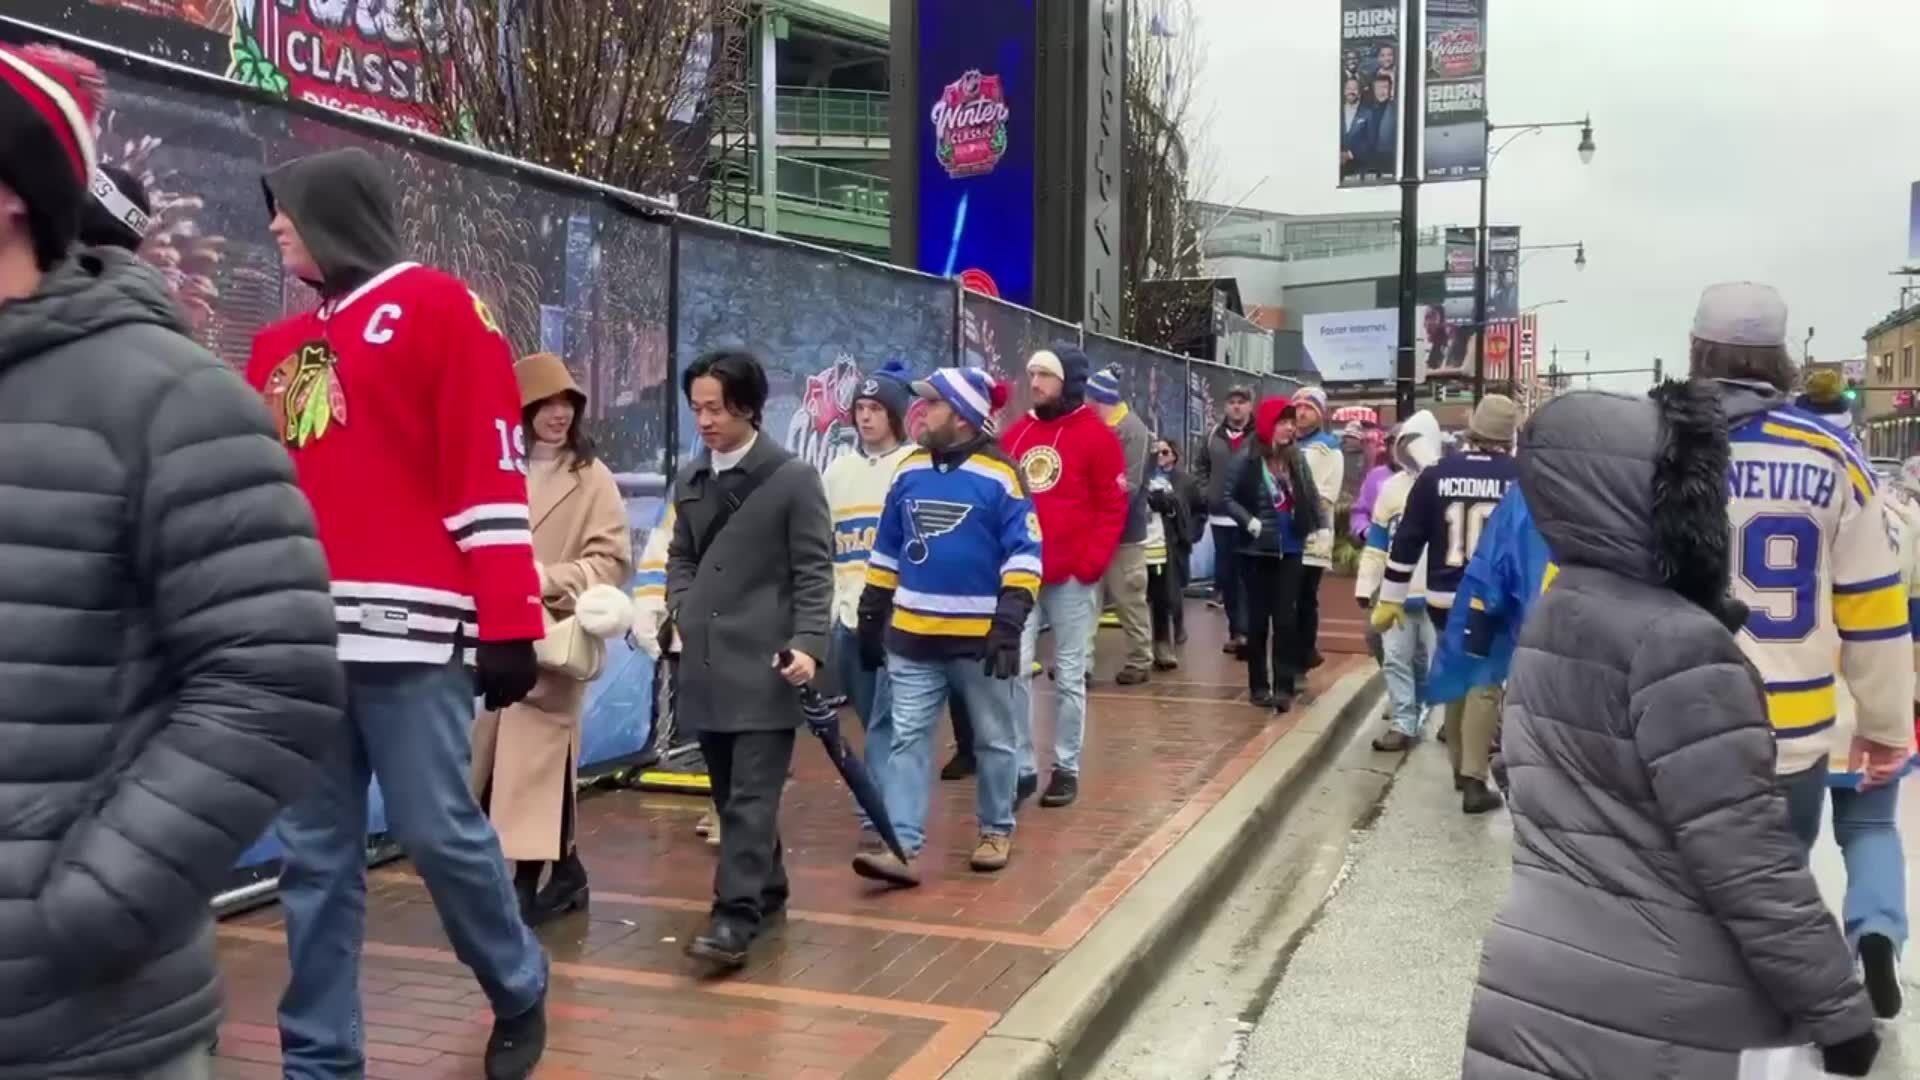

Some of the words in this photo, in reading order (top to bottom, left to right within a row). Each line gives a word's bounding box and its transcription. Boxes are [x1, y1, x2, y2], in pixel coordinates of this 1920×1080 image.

[1343, 8, 1397, 26] BARN
[1343, 24, 1397, 38] BURNER
[287, 31, 425, 103] CLASSI
[1428, 83, 1483, 101] BARN
[931, 95, 1008, 139] Winter
[363, 303, 403, 344] C
[1728, 460, 1836, 508] NEVICH
[1728, 512, 1823, 643] 9
